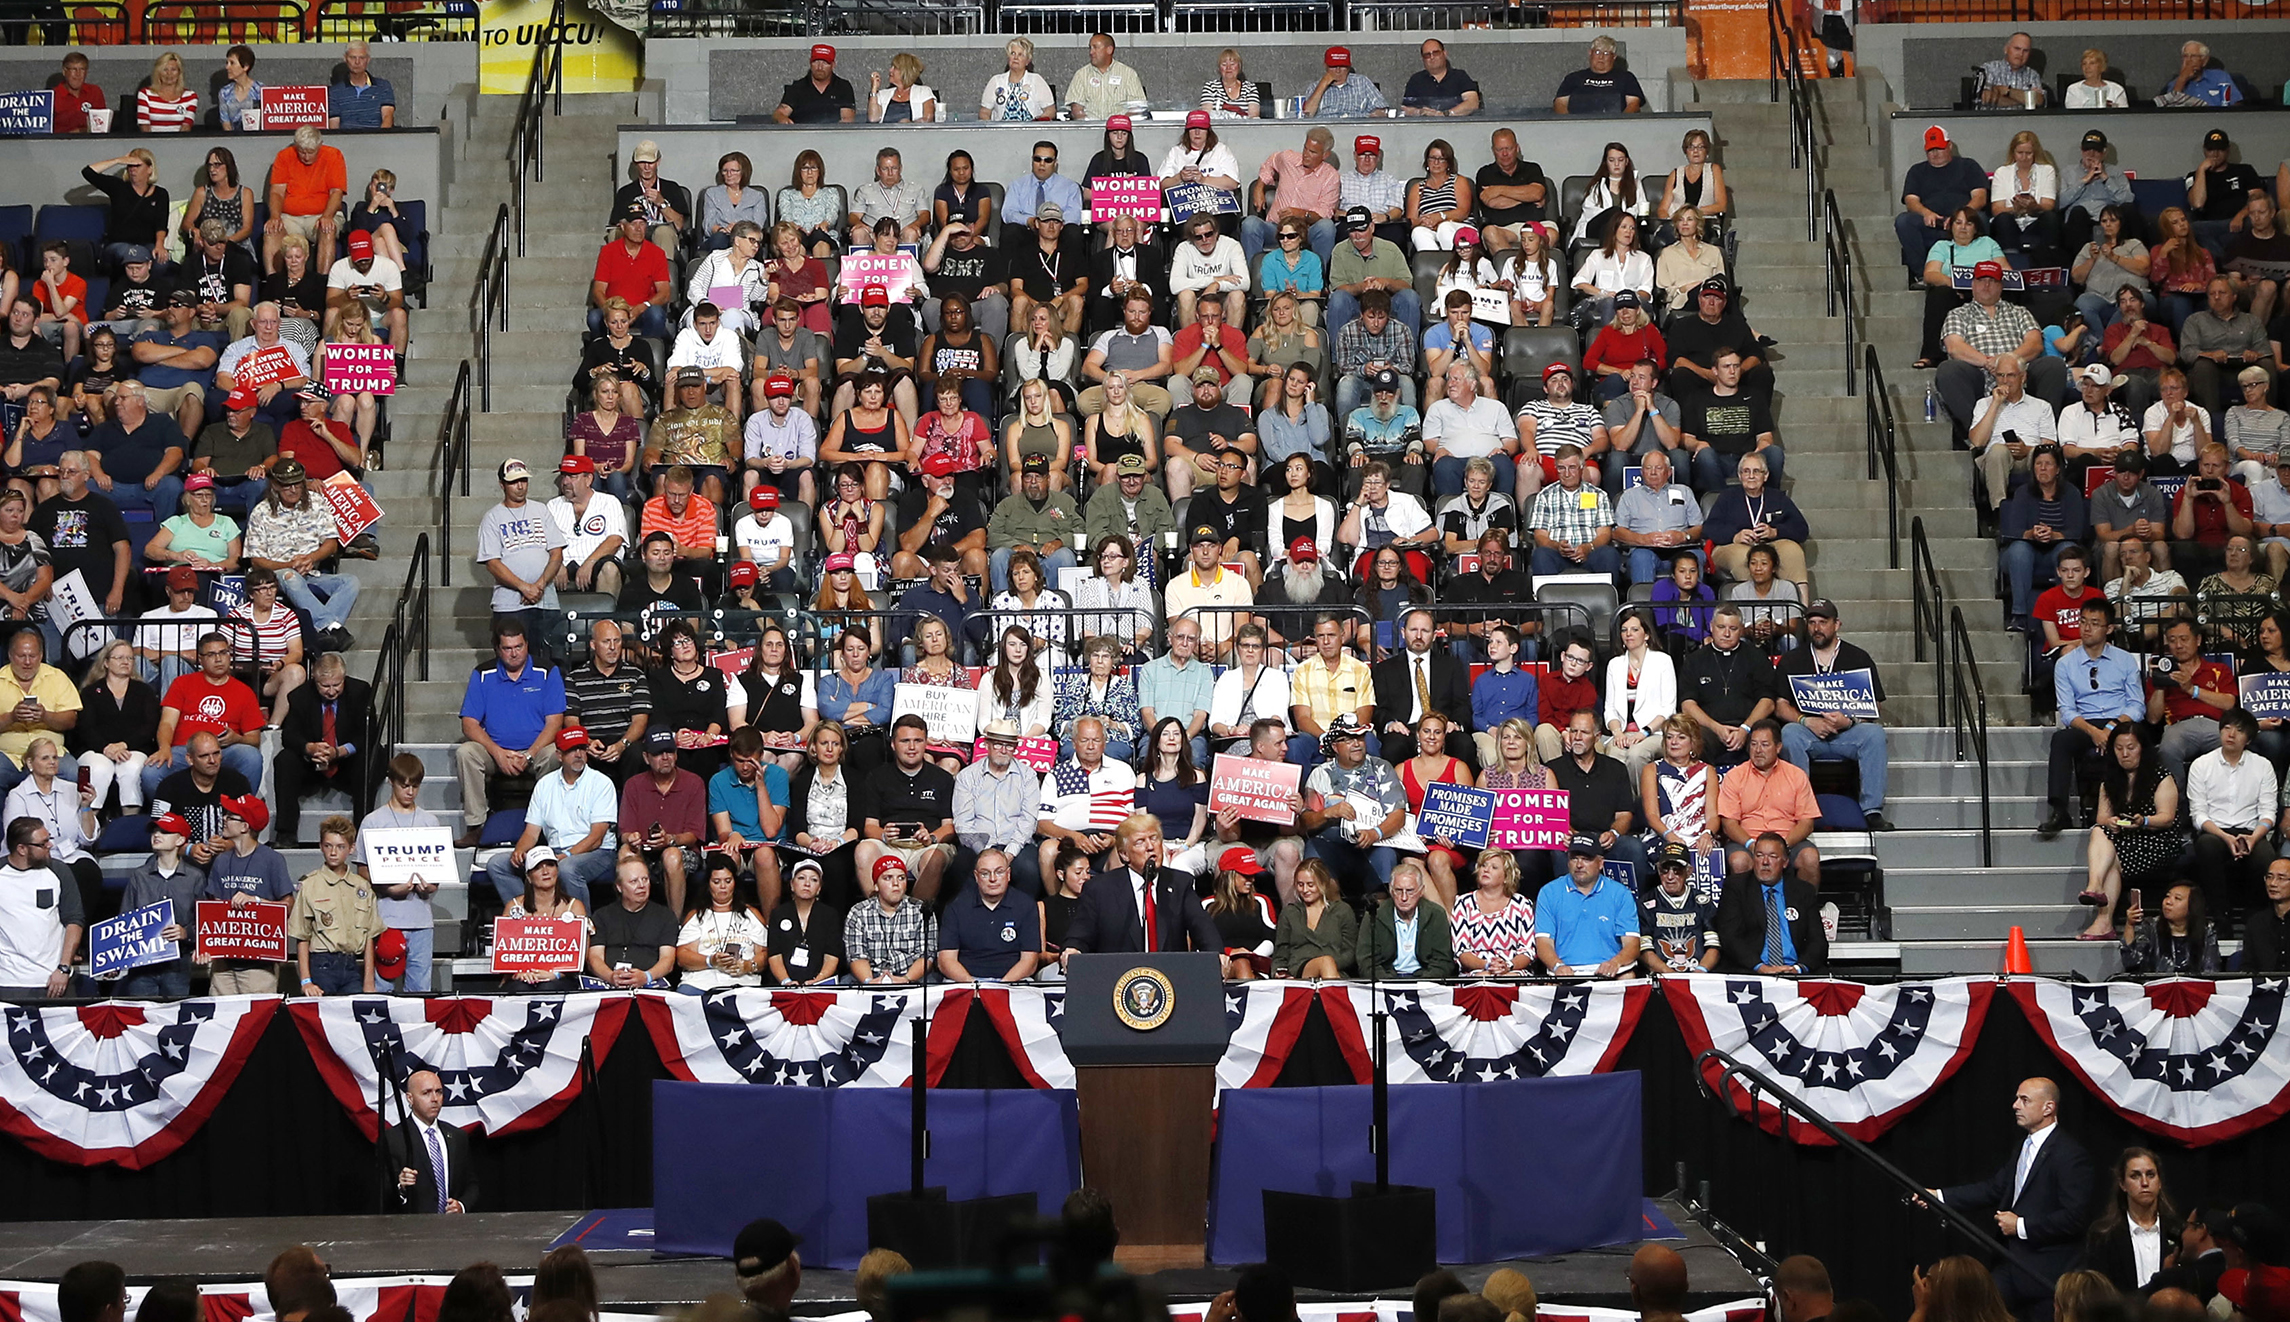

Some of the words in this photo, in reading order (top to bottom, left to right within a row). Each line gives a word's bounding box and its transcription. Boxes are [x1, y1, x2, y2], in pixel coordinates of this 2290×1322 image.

[450, 3, 465, 12] 111
[662, 0, 677, 9] 110
[483, 30, 509, 44] TO
[0, 96, 45, 109] DRAIN
[264, 102, 326, 114] AMERICA
[12, 108, 29, 116] THE
[0, 117, 48, 129] WAMP
[1092, 180, 1160, 191] WOMEN
[1113, 195, 1138, 203] FOR
[1177, 198, 1231, 213] PROMISES
[1095, 208, 1157, 219] TRUMP
[842, 259, 912, 270] WOMEN
[1193, 264, 1223, 275] TRUMP
[869, 275, 890, 284] FOR
[257, 351, 285, 363] GREAT
[327, 348, 394, 360] WOMEN
[937, 348, 980, 359] GREEK
[239, 357, 292, 382] AMERIC
[348, 365, 373, 374] FOR
[255, 372, 279, 384] MAKE
[329, 379, 391, 391] TRUMP
[345, 487, 363, 507] MAKE
[325, 482, 366, 531] AMERICA
[333, 513, 355, 538] AGAIN
[499, 517, 547, 549] USA
[747, 538, 780, 546] TRUMP
[63, 583, 99, 642] TRUP
[1817, 680, 1844, 689] MAKE
[2267, 679, 2290, 687] MAK
[926, 691, 949, 700] BUY
[1797, 689, 1872, 701] AMERICA
[2243, 688, 2290, 703] AMER
[899, 699, 972, 716] AMERICAN
[1799, 700, 1841, 710] STRONG
[1842, 702, 1876, 711] AGAIN
[2252, 701, 2280, 713] SAFE
[921, 712, 948, 722] HIRE
[927, 721, 971, 735] RICAN
[1241, 766, 1271, 782] MAKE
[1213, 775, 1294, 800] AMERICA
[1217, 792, 1253, 807] GREAT
[1253, 797, 1287, 812] AGAIN
[1431, 788, 1488, 809] PROMISES
[1495, 794, 1569, 810] WOMEN
[1438, 801, 1473, 816] MADE
[1424, 812, 1483, 833] PROMISES
[1513, 813, 1544, 825] FOR
[1433, 826, 1465, 841] KEPT
[1494, 830, 1567, 846] TRUMP
[374, 845, 446, 855] TRUMP
[227, 910, 257, 920] MAKE
[1656, 912, 1697, 928] NAVY
[100, 908, 163, 941] DRAIN
[200, 921, 285, 939] AMERICA
[120, 930, 143, 945] THE
[524, 928, 554, 938] MAKE
[205, 937, 242, 948] GREAT
[246, 939, 280, 951] AGAIN
[496, 938, 580, 952] AMERICA
[95, 937, 169, 968] SWAMP
[501, 952, 535, 963] GREAT
[537, 952, 574, 963] AGAIN
[1115, 970, 1142, 998] PRESIDENT
[1160, 977, 1173, 1004] UNITED
[1149, 1008, 1170, 1028] STATES
